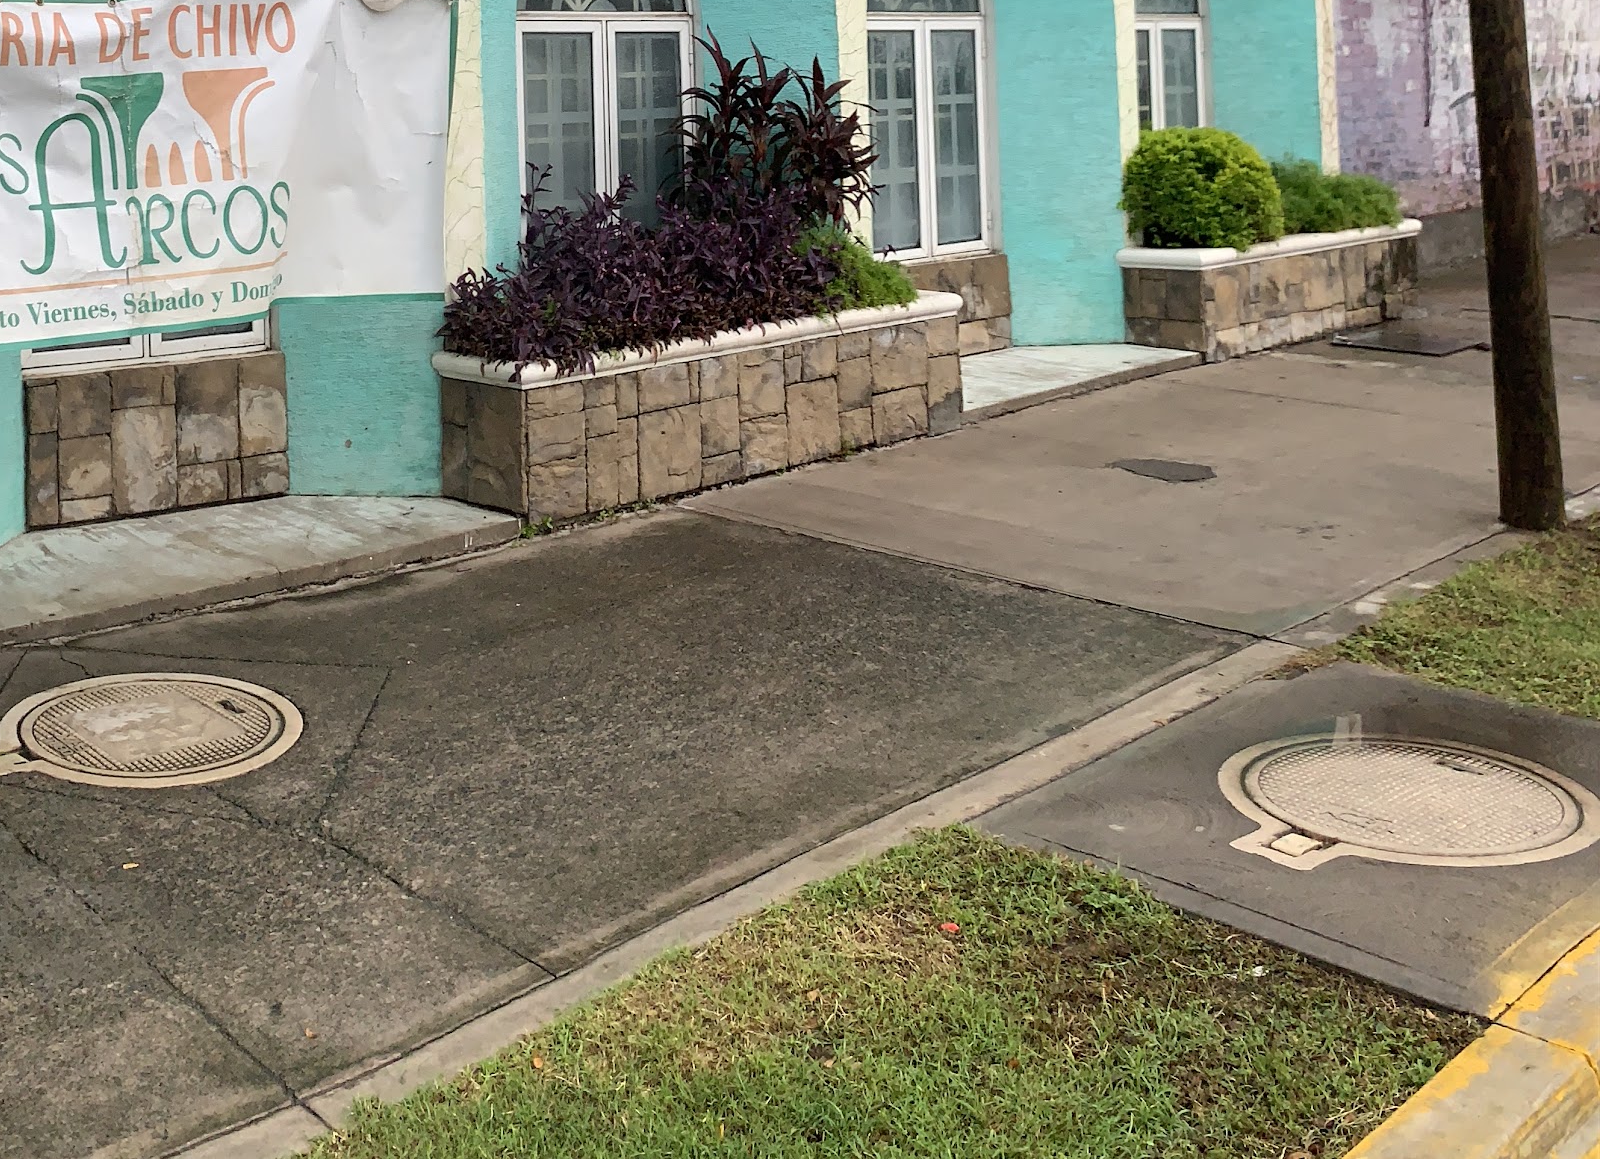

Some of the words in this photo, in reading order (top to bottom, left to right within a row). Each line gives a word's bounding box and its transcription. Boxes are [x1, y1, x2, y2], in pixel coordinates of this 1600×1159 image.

[95, 7, 153, 64] DE
[167, 1, 296, 59] CHIVO
[26, 302, 118, 326] Viernes,
[123, 287, 204, 316] Sábado
[211, 290, 223, 312] y
